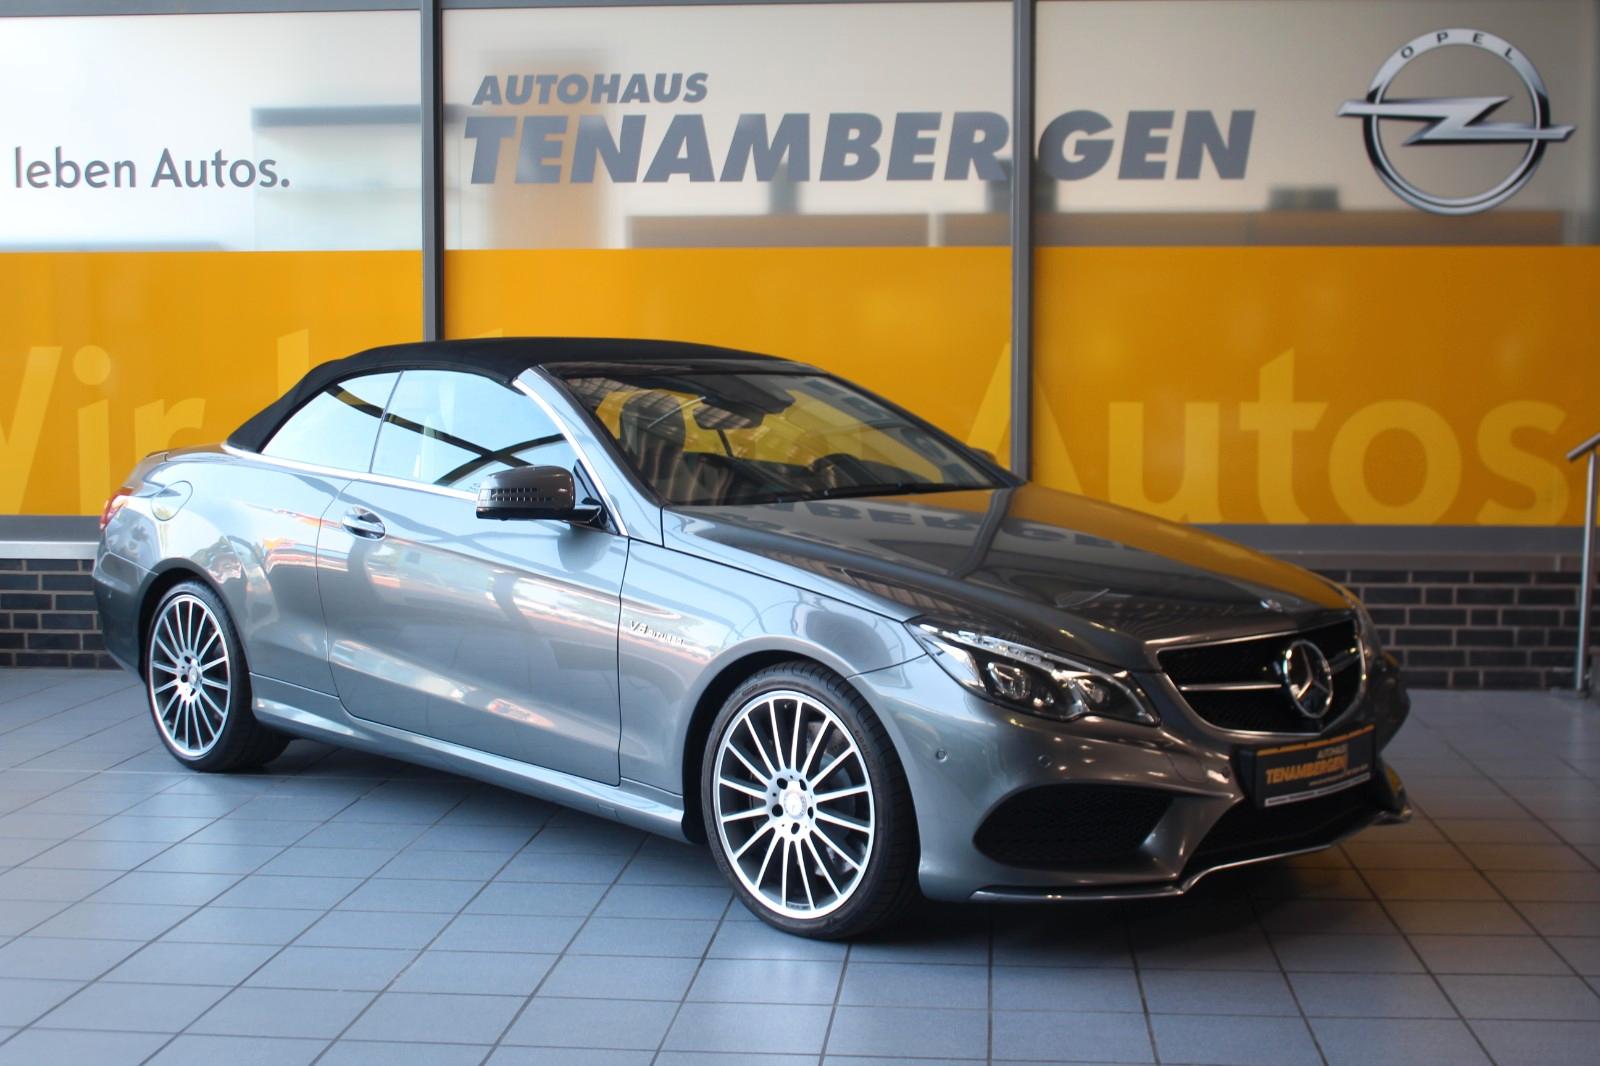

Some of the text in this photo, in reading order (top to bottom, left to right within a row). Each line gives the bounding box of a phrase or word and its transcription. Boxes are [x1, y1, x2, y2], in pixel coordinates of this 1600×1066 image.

[1400, 31, 1514, 61] OPEL
[472, 72, 709, 105] AUTOHAUS
[464, 110, 1256, 185] TENAMBERGEN
[14, 146, 291, 188] leben Autos.
